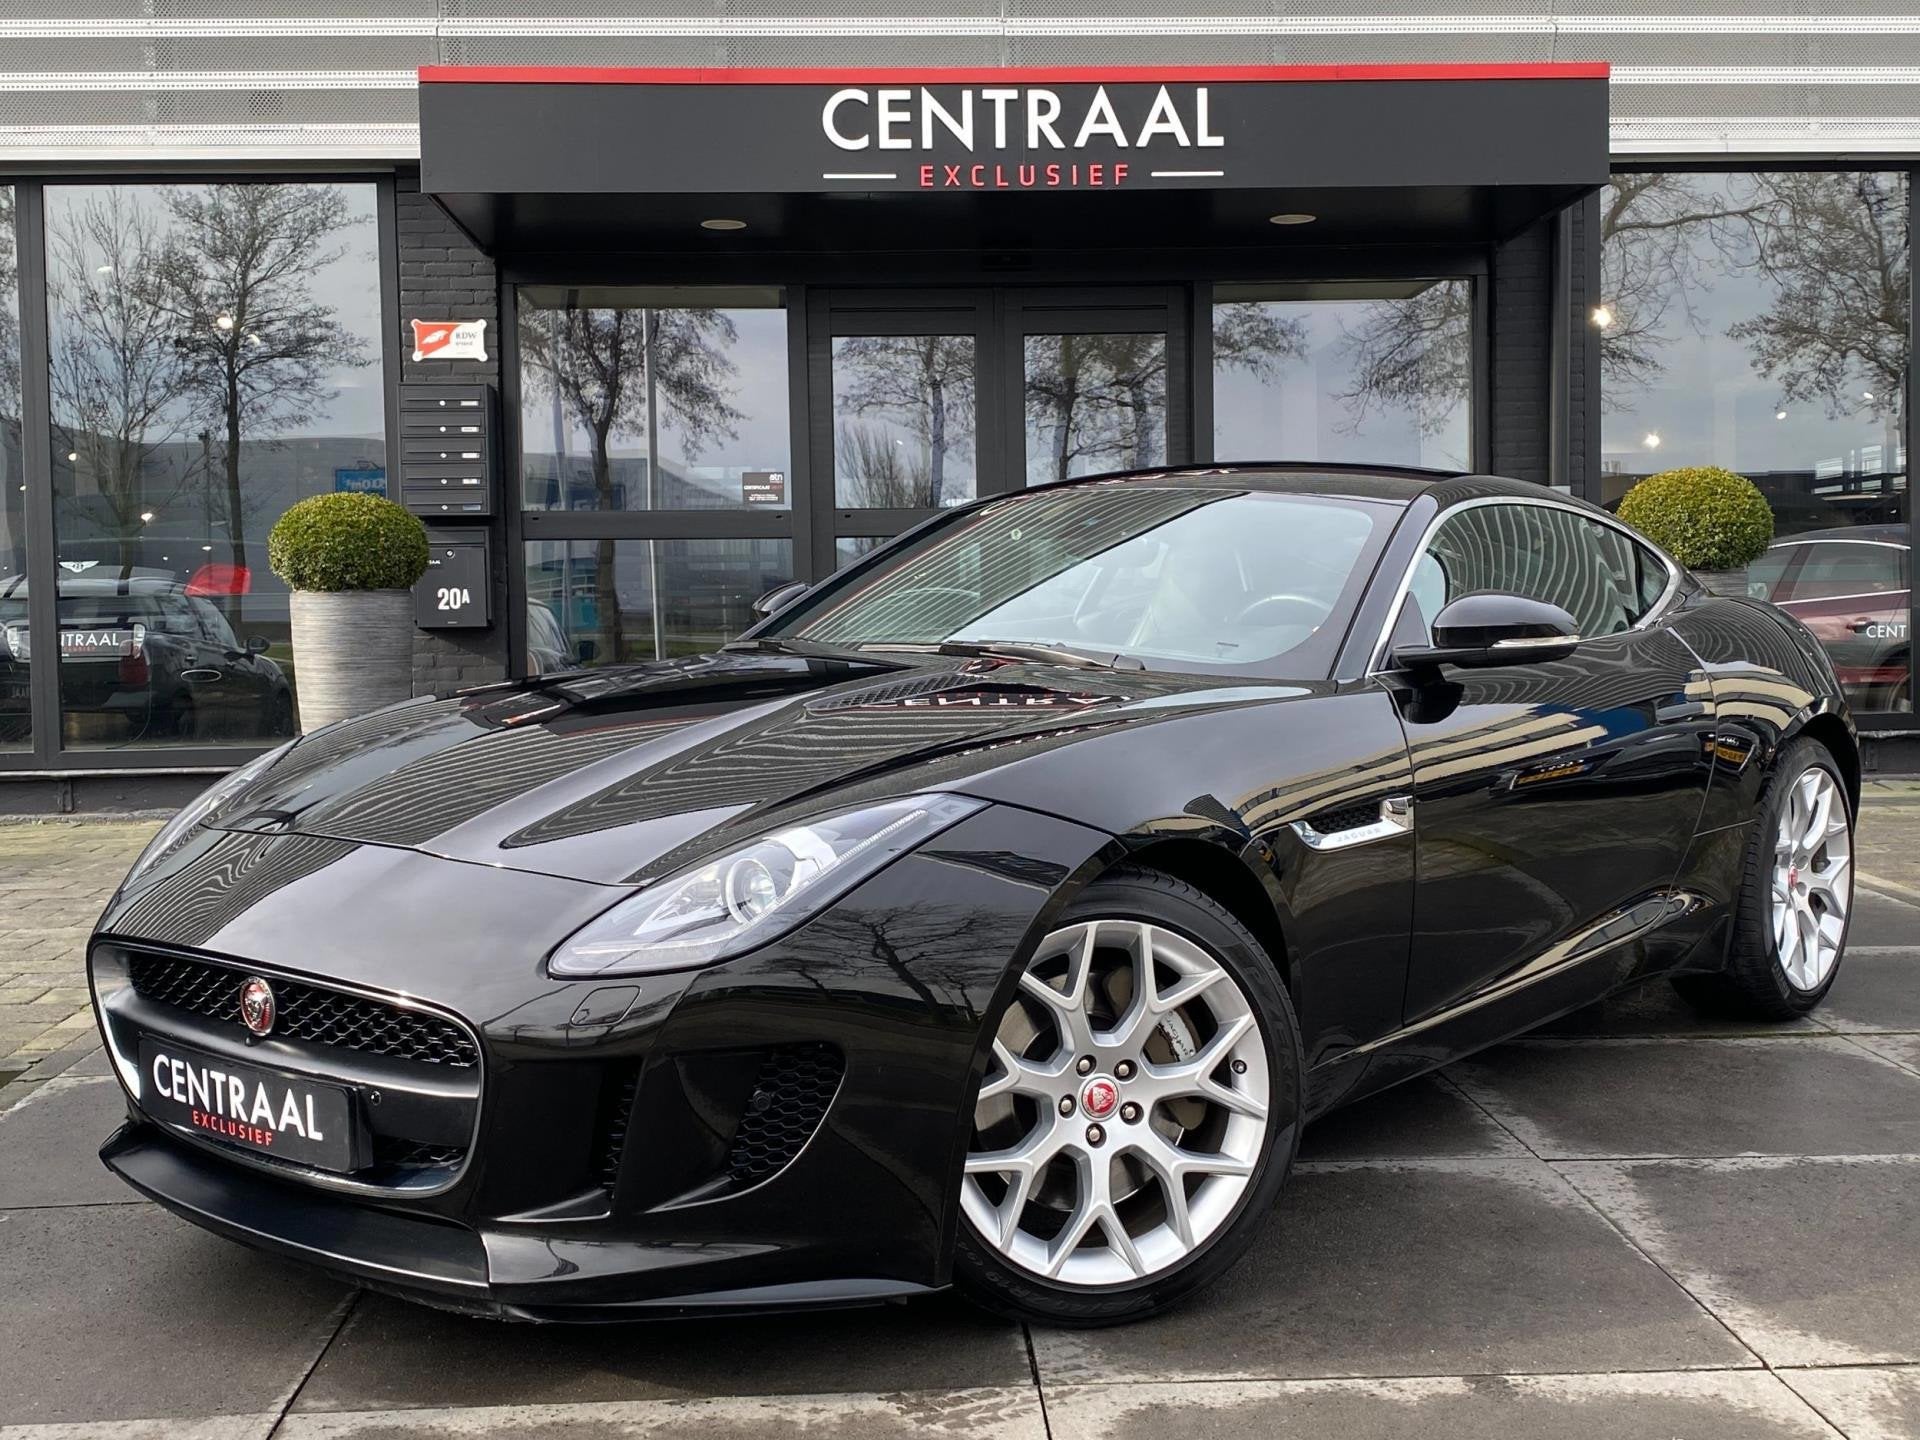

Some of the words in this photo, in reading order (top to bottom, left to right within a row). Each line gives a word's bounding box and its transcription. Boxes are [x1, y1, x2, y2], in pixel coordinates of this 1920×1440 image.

[822, 84, 1225, 152] CENTRAAL
[919, 163, 1130, 187] EXCLUSIEF
[437, 587, 471, 611] 20A
[1866, 624, 1907, 639] CENT
[153, 1054, 324, 1142] CENTRAAL
[192, 1110, 274, 1147] EXCLUSIEF
